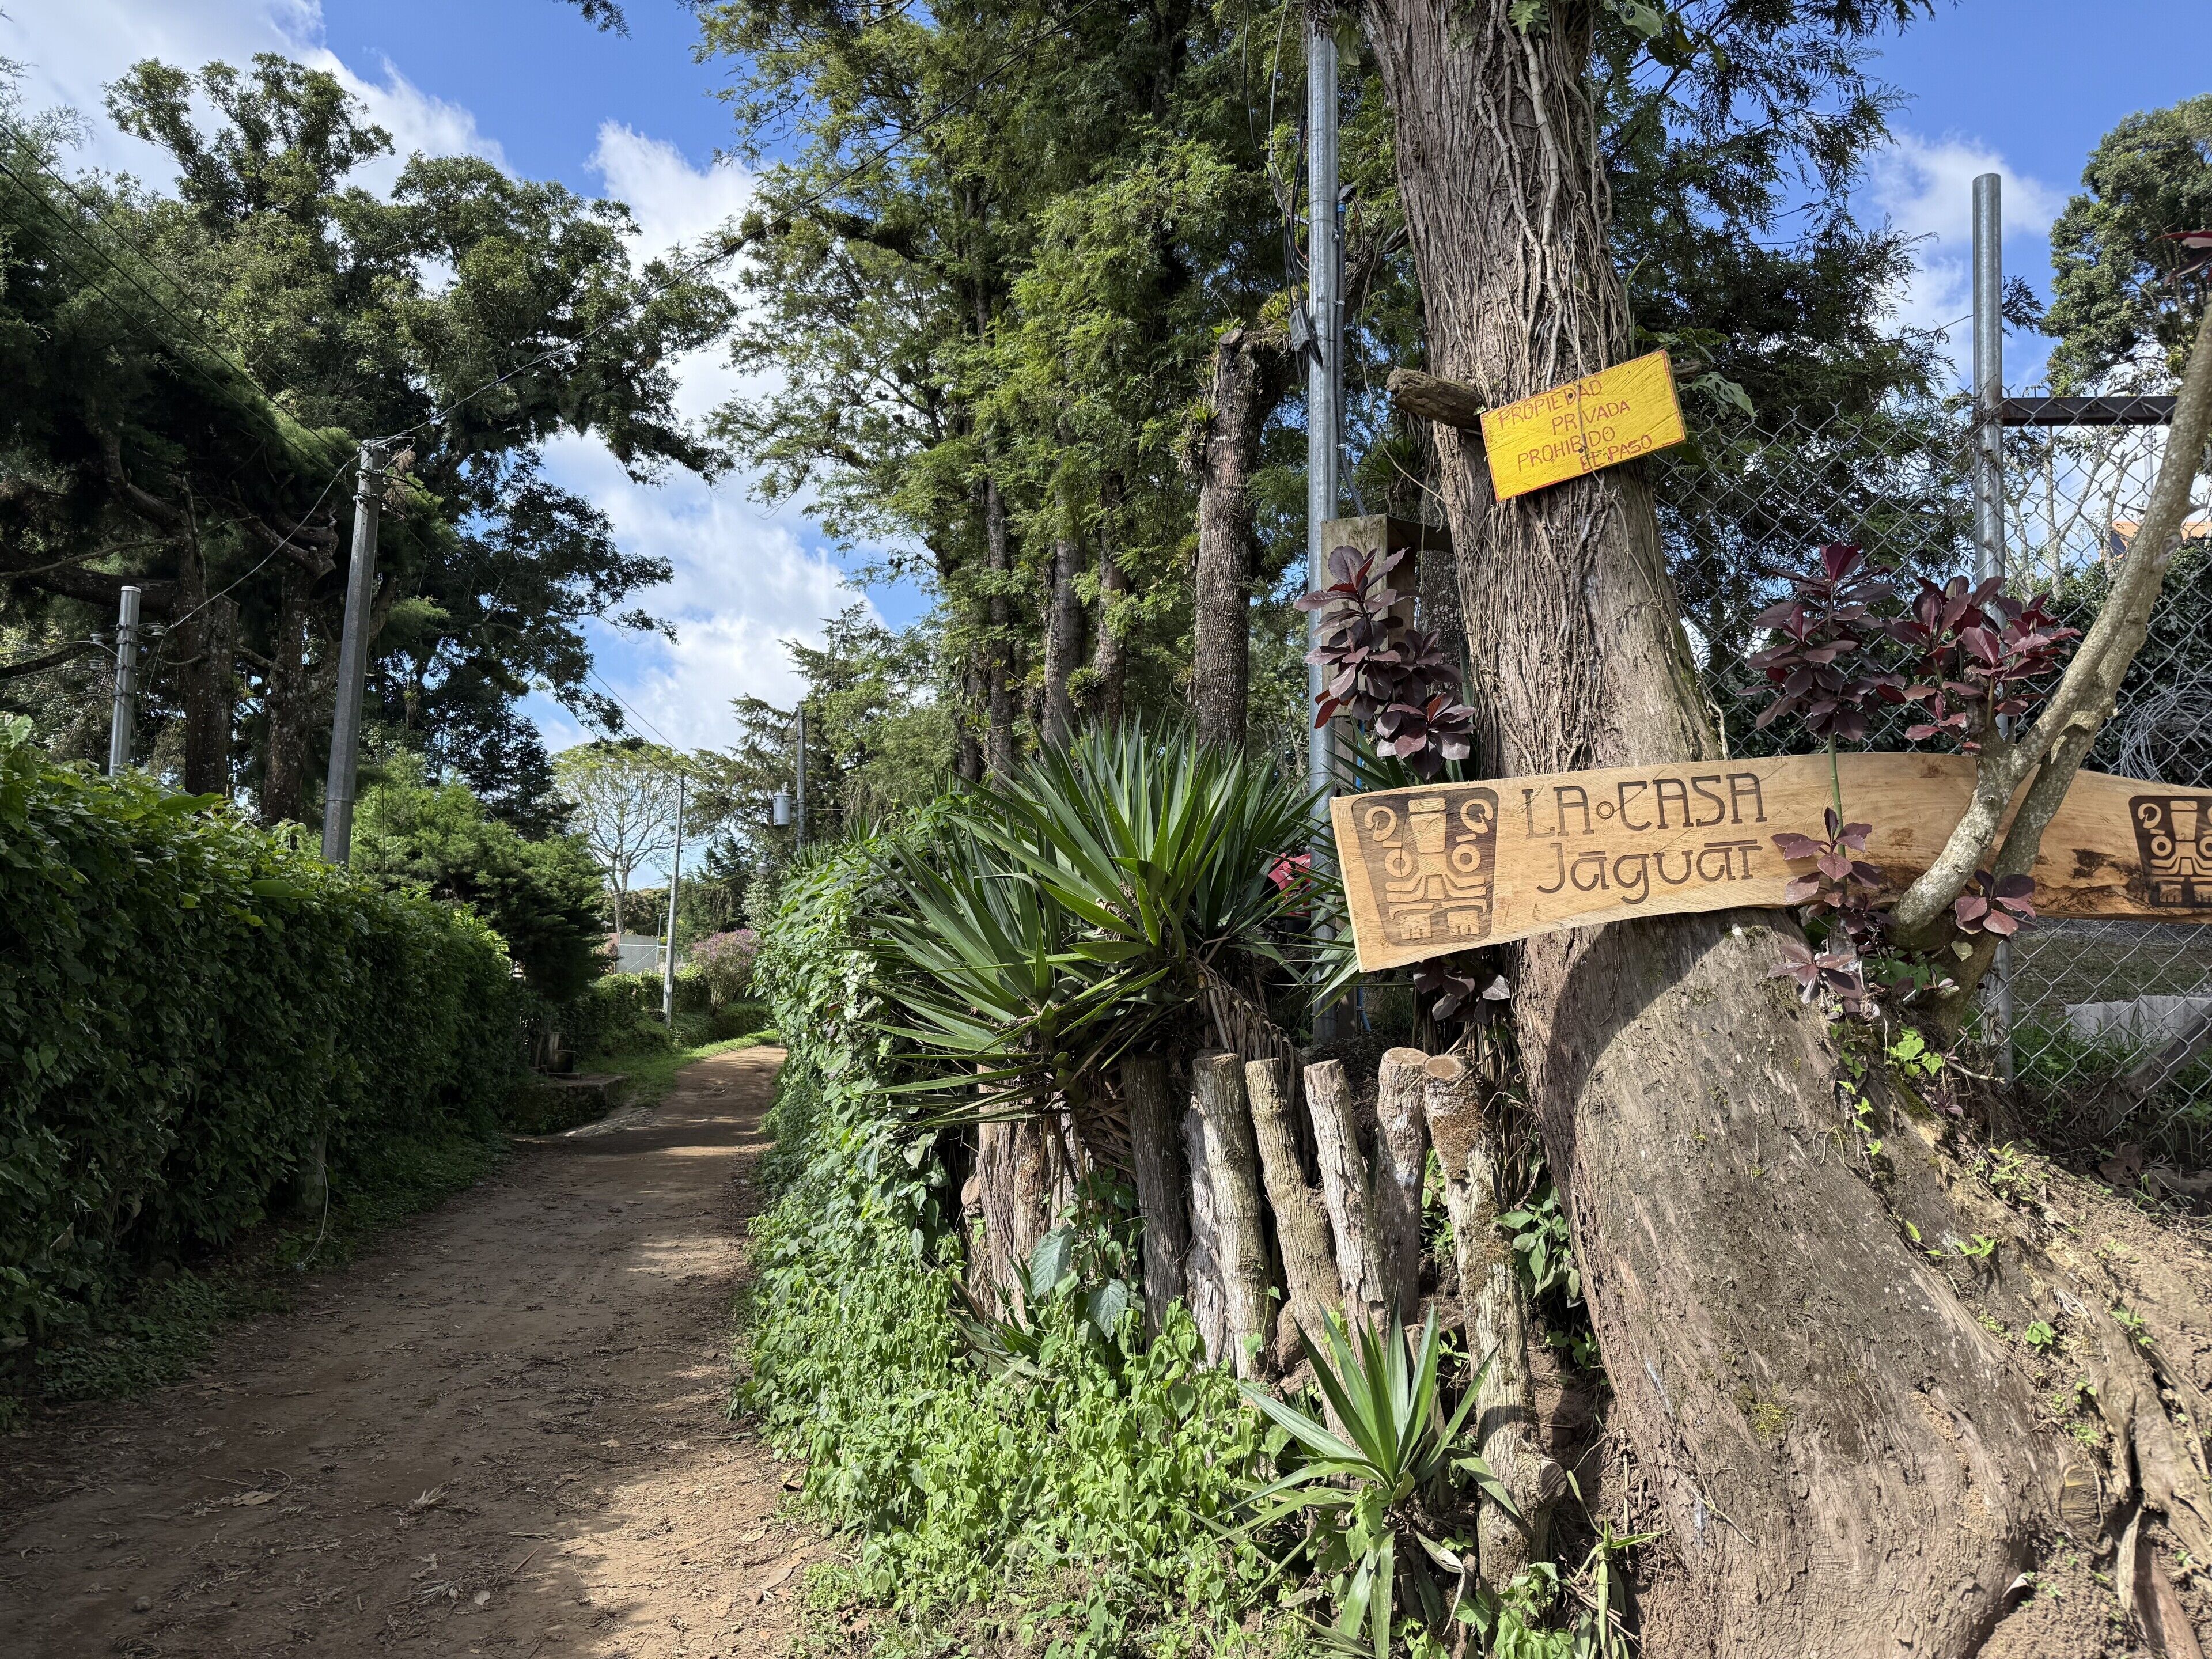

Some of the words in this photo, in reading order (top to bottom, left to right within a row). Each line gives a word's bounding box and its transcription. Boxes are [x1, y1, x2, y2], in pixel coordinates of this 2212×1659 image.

[1498, 379, 1602, 429] PROPIEDAD
[1517, 426, 1616, 472] PROHIBIDO
[1607, 434, 1652, 461] PASO
